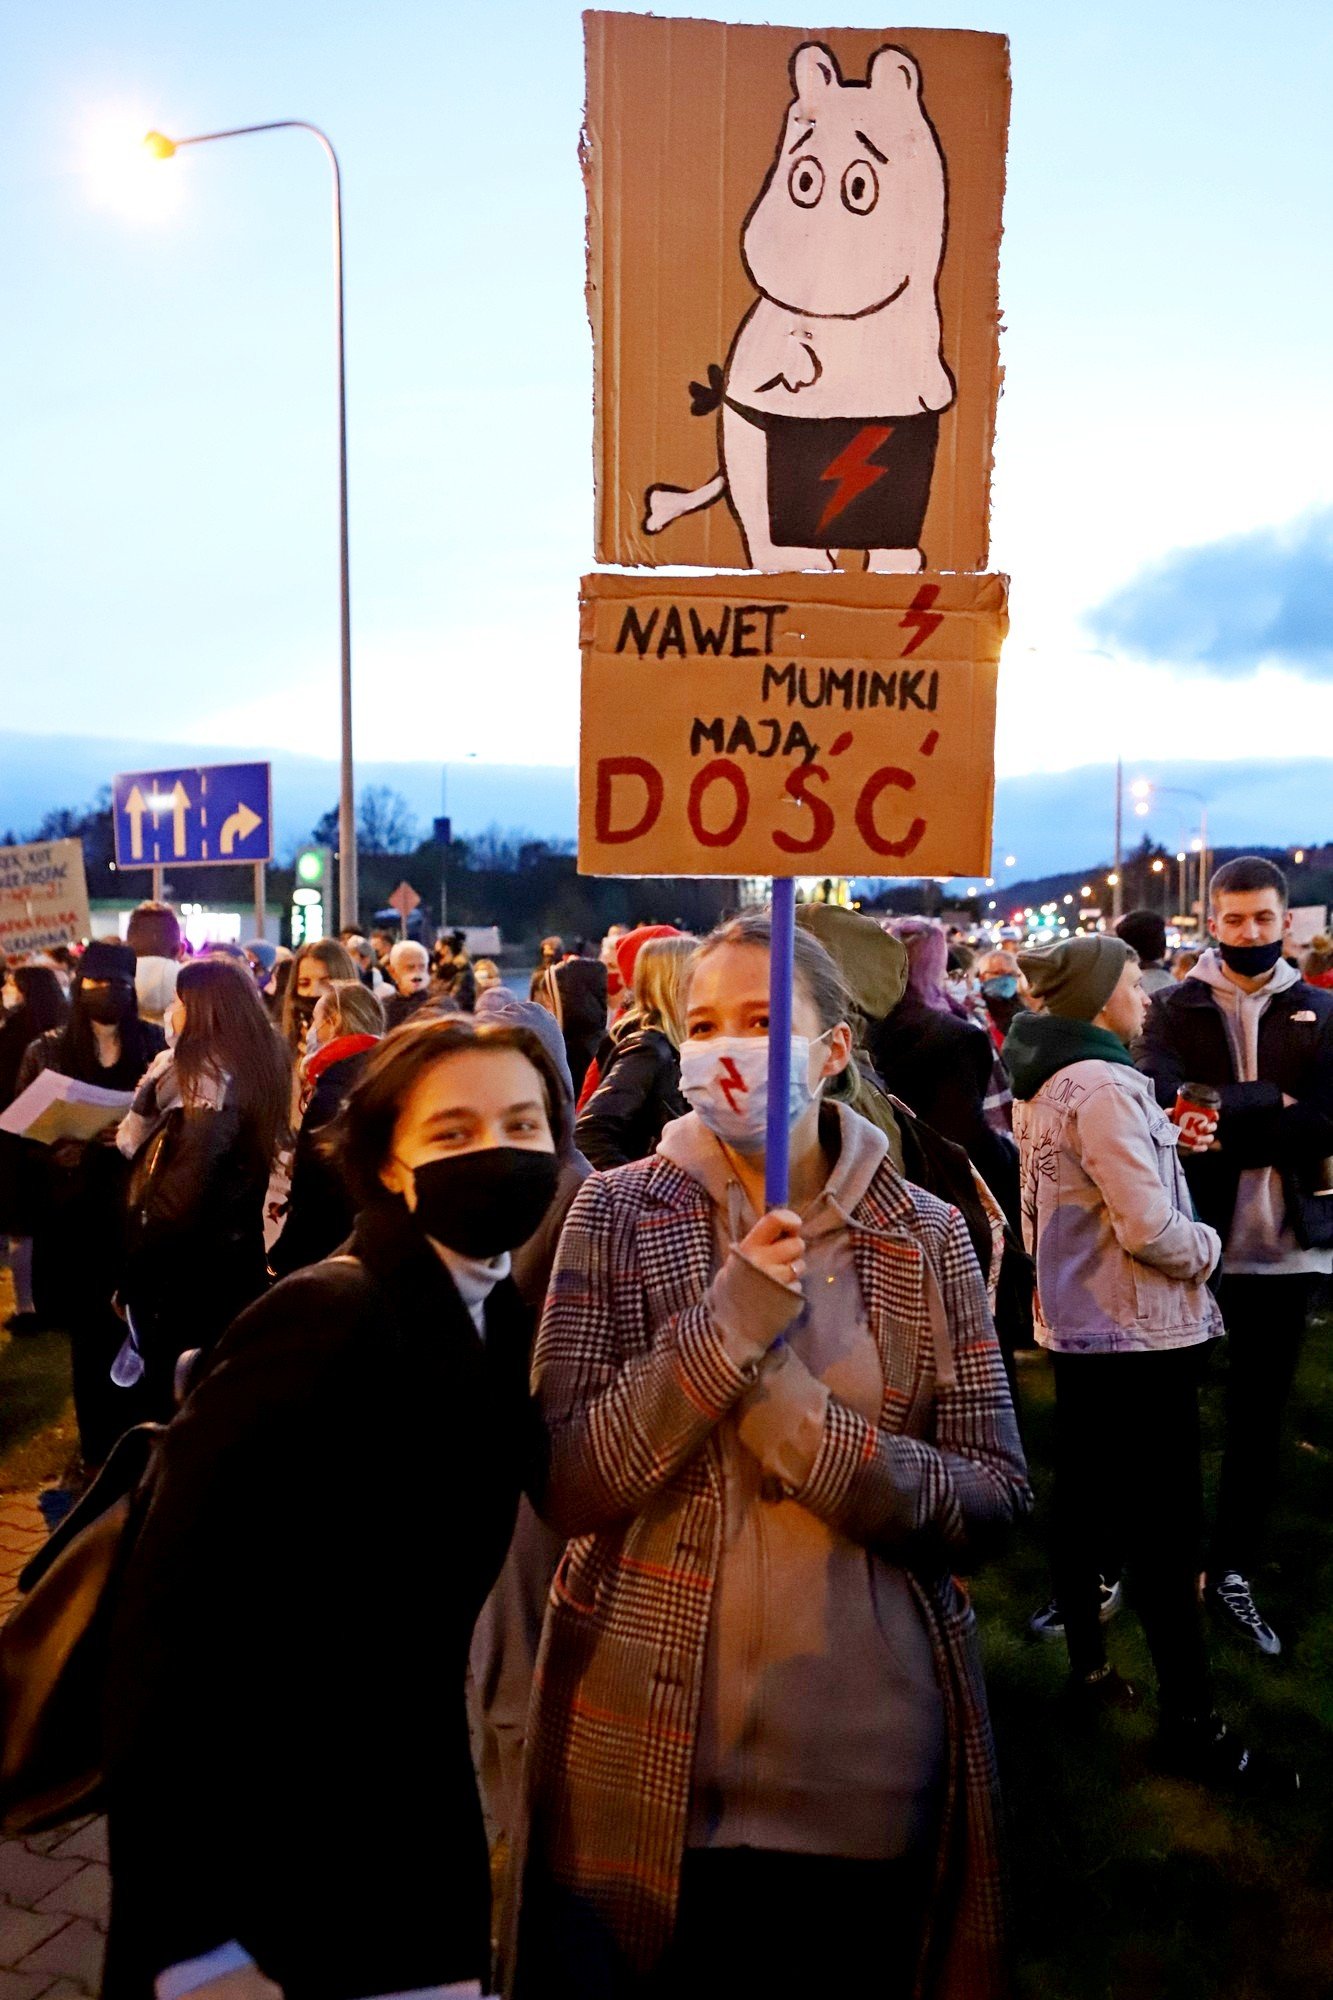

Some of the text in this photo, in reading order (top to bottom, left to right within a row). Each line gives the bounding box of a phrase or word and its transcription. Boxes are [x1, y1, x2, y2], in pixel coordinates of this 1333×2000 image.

[615, 603, 789, 659] NAWET
[761, 662, 940, 712] MUMINKI
[689, 715, 820, 766] MAJĄ
[594, 730, 939, 858] DOŚĆ
